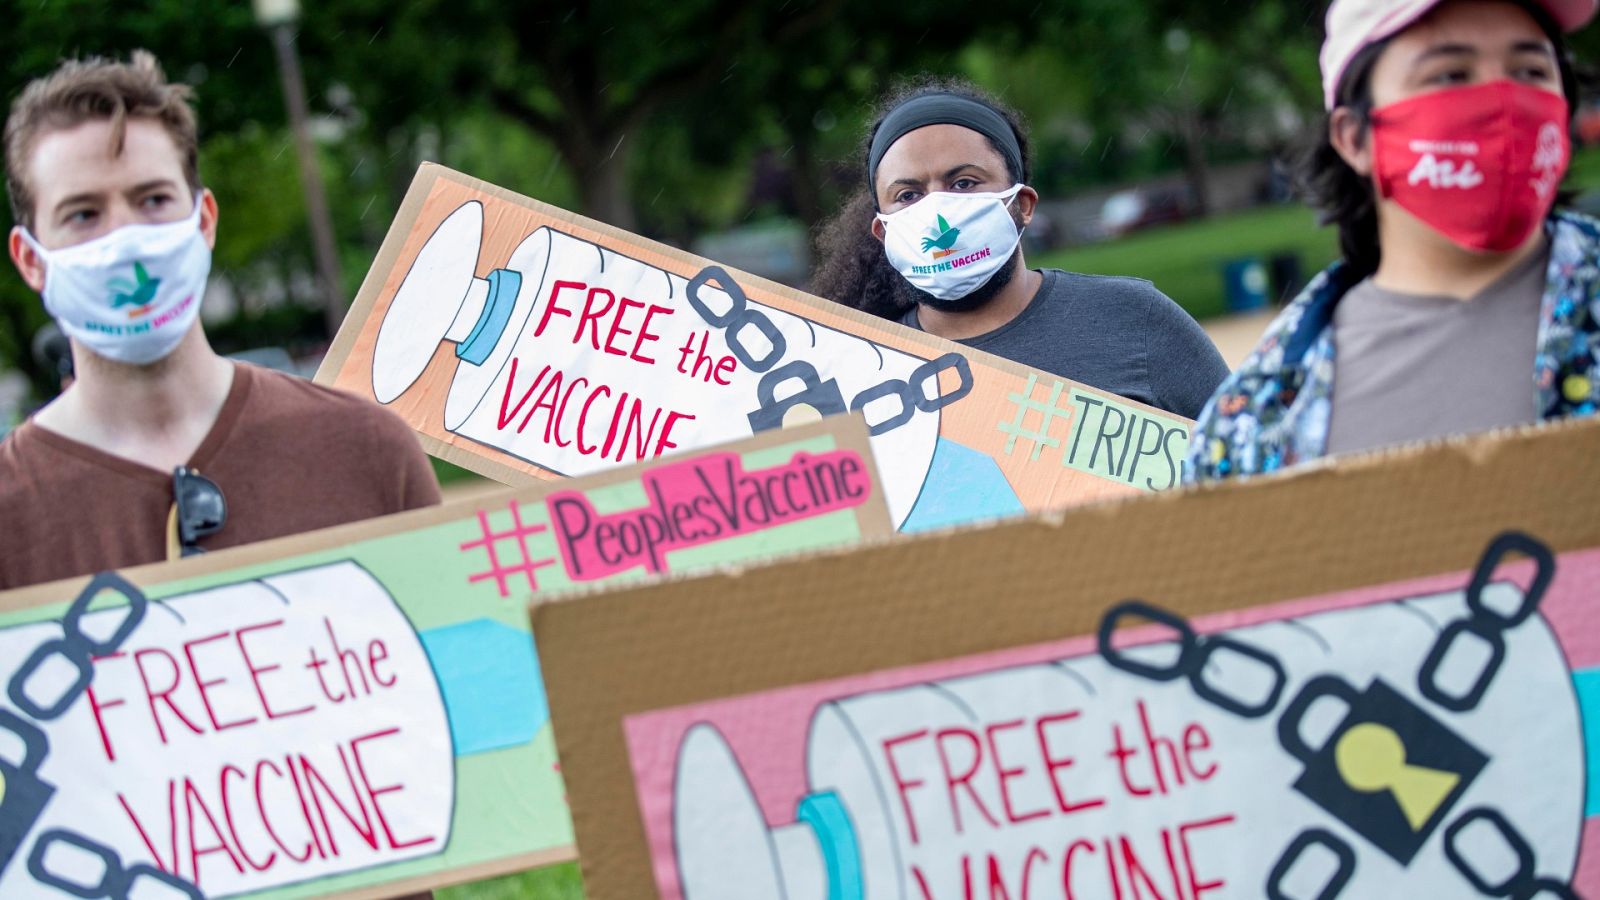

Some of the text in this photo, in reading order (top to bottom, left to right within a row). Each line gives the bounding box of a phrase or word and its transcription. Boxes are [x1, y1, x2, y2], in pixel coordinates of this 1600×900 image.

[534, 280, 738, 386] FREE the
[997, 373, 1186, 492] #TRIPS
[459, 450, 867, 597] #PeoplesVaccine
[84, 617, 398, 762] FREE the
[117, 728, 436, 886] VACCINE
[882, 699, 1219, 844] FREE the
